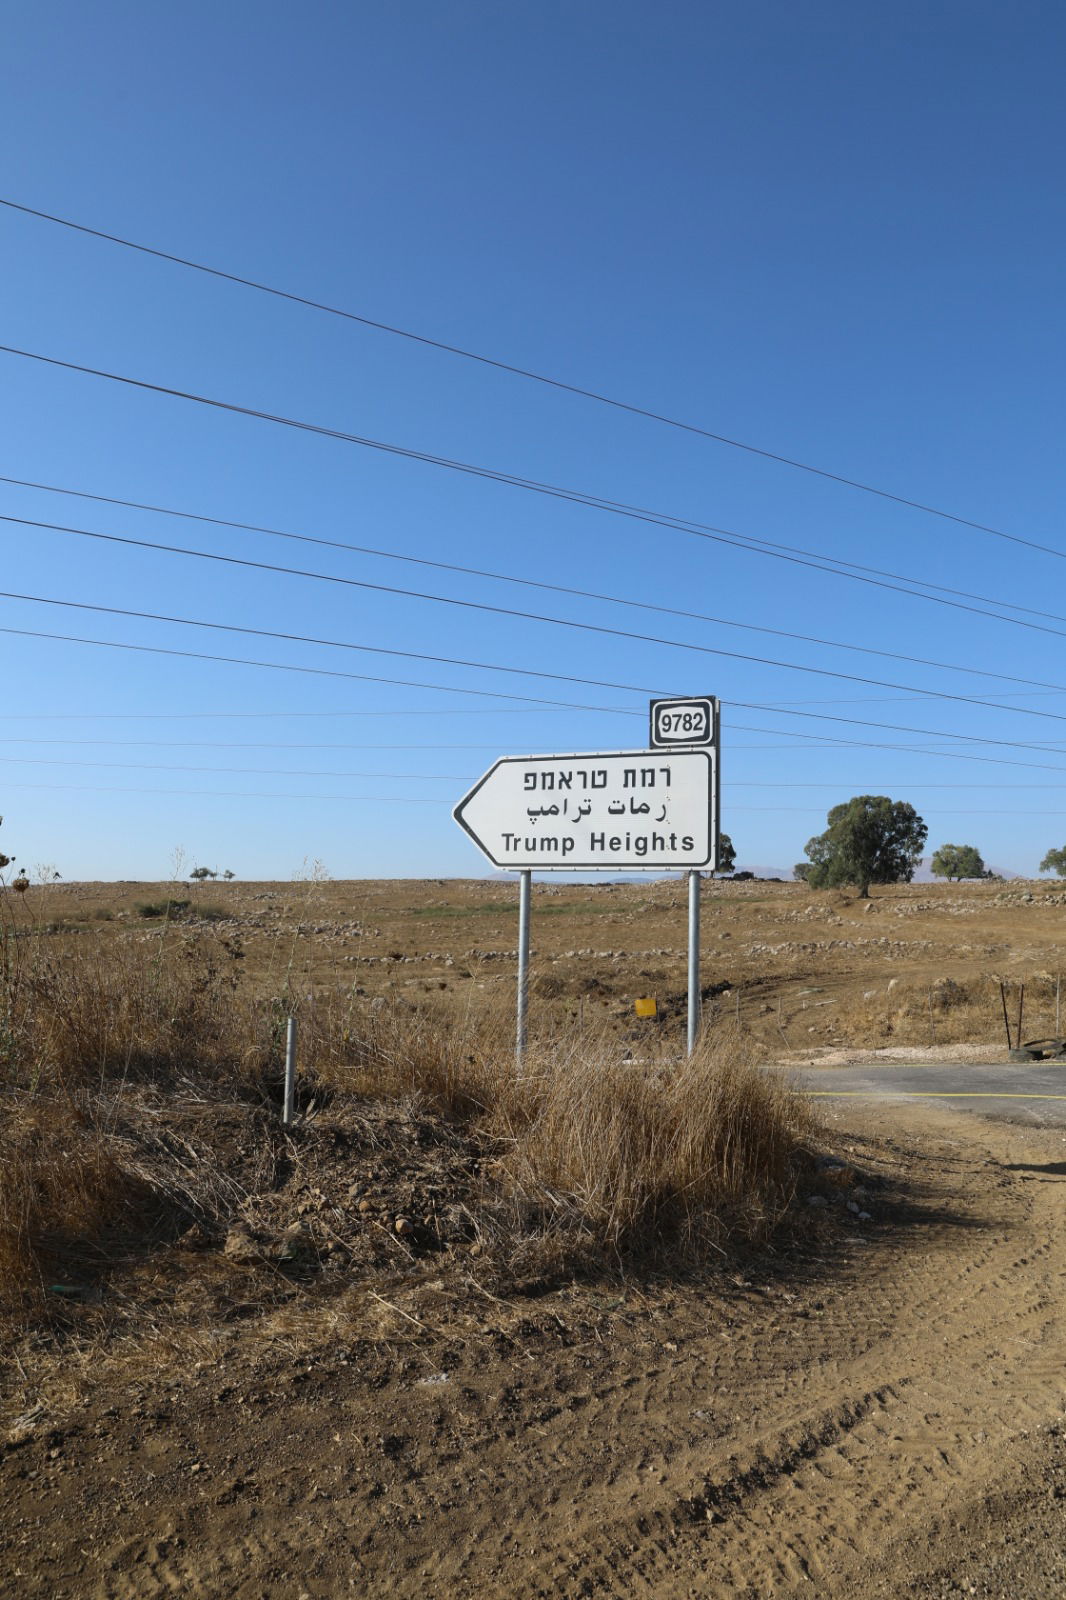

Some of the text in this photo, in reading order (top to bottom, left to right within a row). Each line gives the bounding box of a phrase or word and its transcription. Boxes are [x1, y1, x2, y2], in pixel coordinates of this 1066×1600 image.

[661, 712, 704, 733] 9782
[523, 766, 672, 791] רמת טראמפ
[526, 796, 667, 825] رمات ترامپ
[501, 831, 695, 857] Trump Heights
